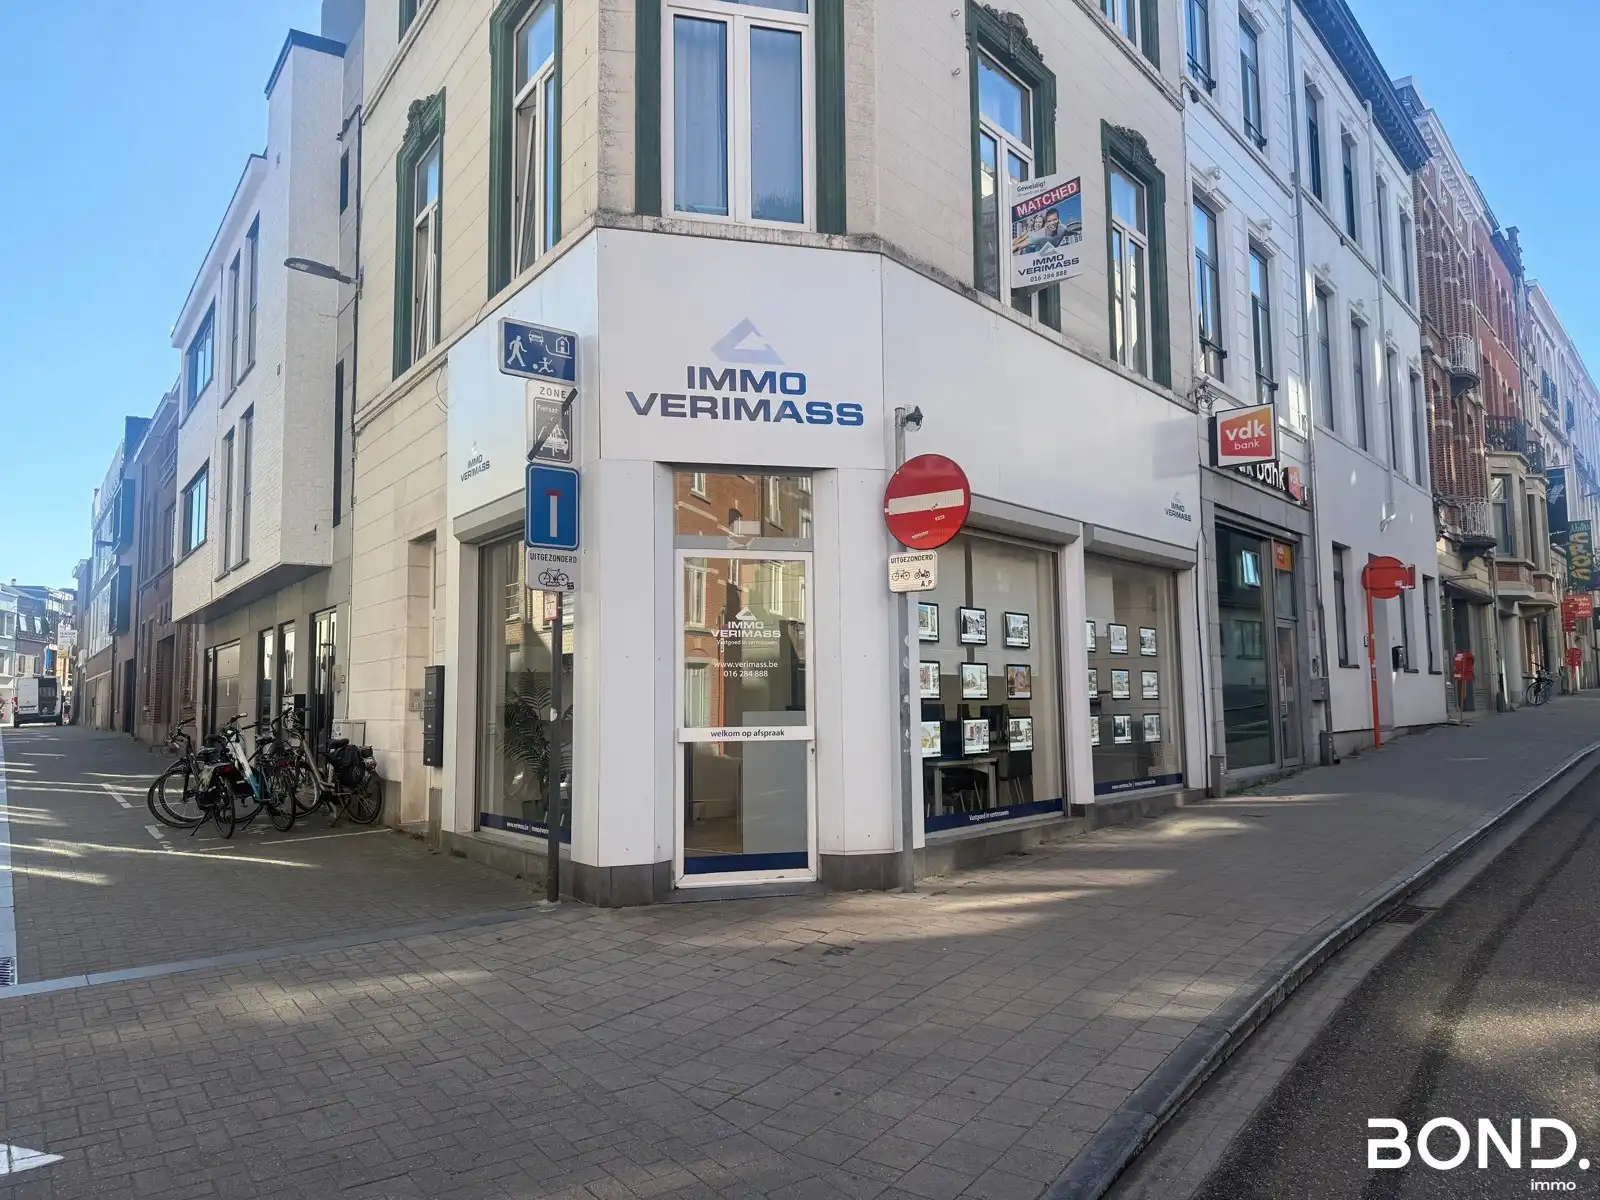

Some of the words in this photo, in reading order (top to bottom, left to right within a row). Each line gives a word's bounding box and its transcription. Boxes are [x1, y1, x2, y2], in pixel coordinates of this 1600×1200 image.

[1016, 182, 1078, 217] MATCHED
[1018, 257, 1080, 276] VERIMASS
[1032, 253, 1065, 267] IMMO
[1029, 274, 1042, 283] 016
[1043, 272, 1055, 280] 284
[1055, 269, 1068, 278] 888
[686, 365, 807, 396] IMMO
[539, 386, 567, 399] ZONE
[624, 390, 865, 427] VERIMASS
[1224, 418, 1267, 442] vdk
[1234, 439, 1260, 451] bank
[529, 552, 578, 564] UITGEZONDERD
[890, 553, 934, 564] UITGEZONDERD
[727, 621, 764, 629] IMMO
[710, 629, 782, 638] VERIMASS
[723, 670, 738, 678] 016
[739, 670, 754, 678] 284
[754, 670, 769, 678] 888
[710, 730, 741, 738] welkom
[741, 730, 752, 740] op
[753, 728, 785, 739] afspraak
